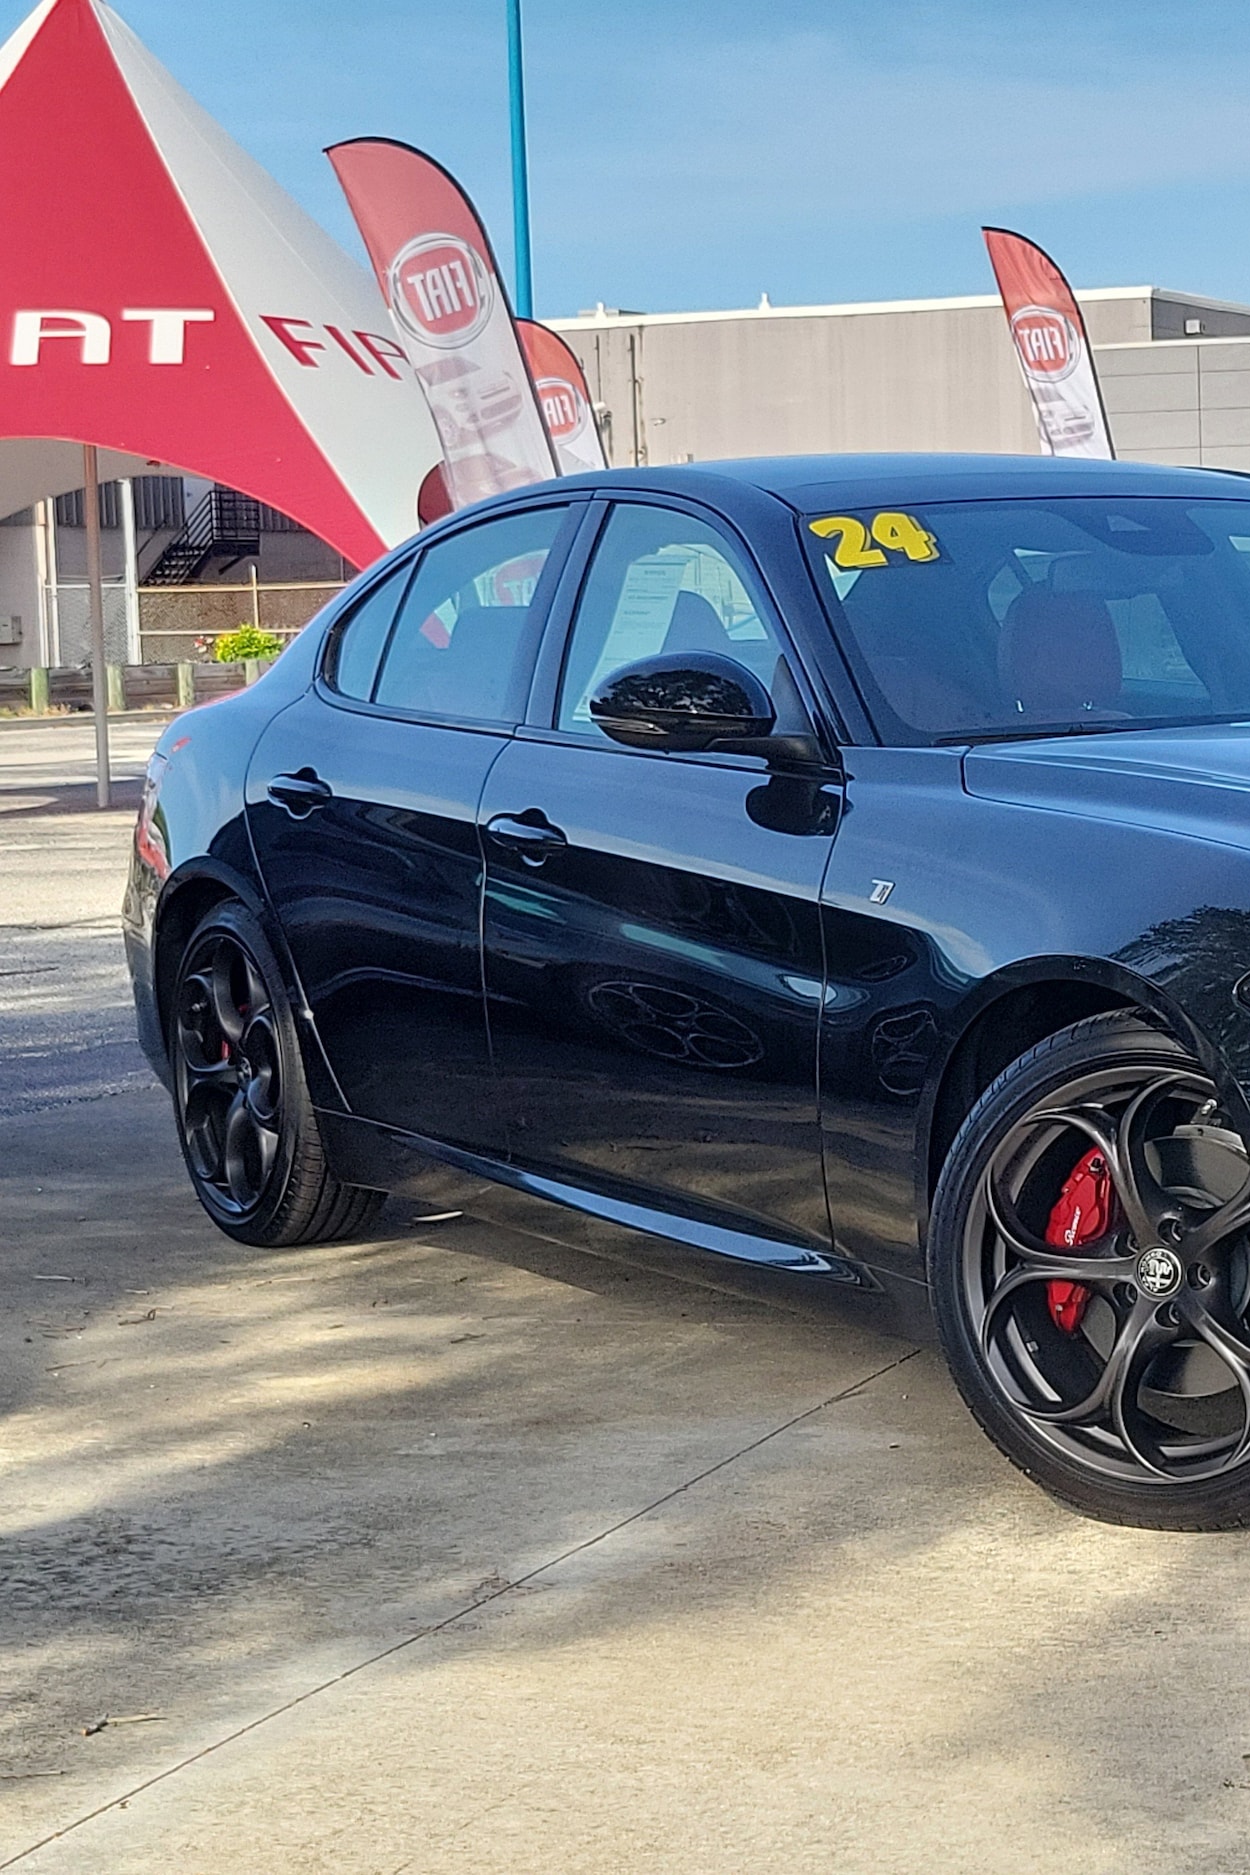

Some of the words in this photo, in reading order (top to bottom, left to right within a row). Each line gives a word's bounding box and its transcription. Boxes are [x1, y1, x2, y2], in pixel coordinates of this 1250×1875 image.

[10, 308, 214, 366] AT
[258, 315, 412, 381] FIA
[808, 511, 941, 568] 24
